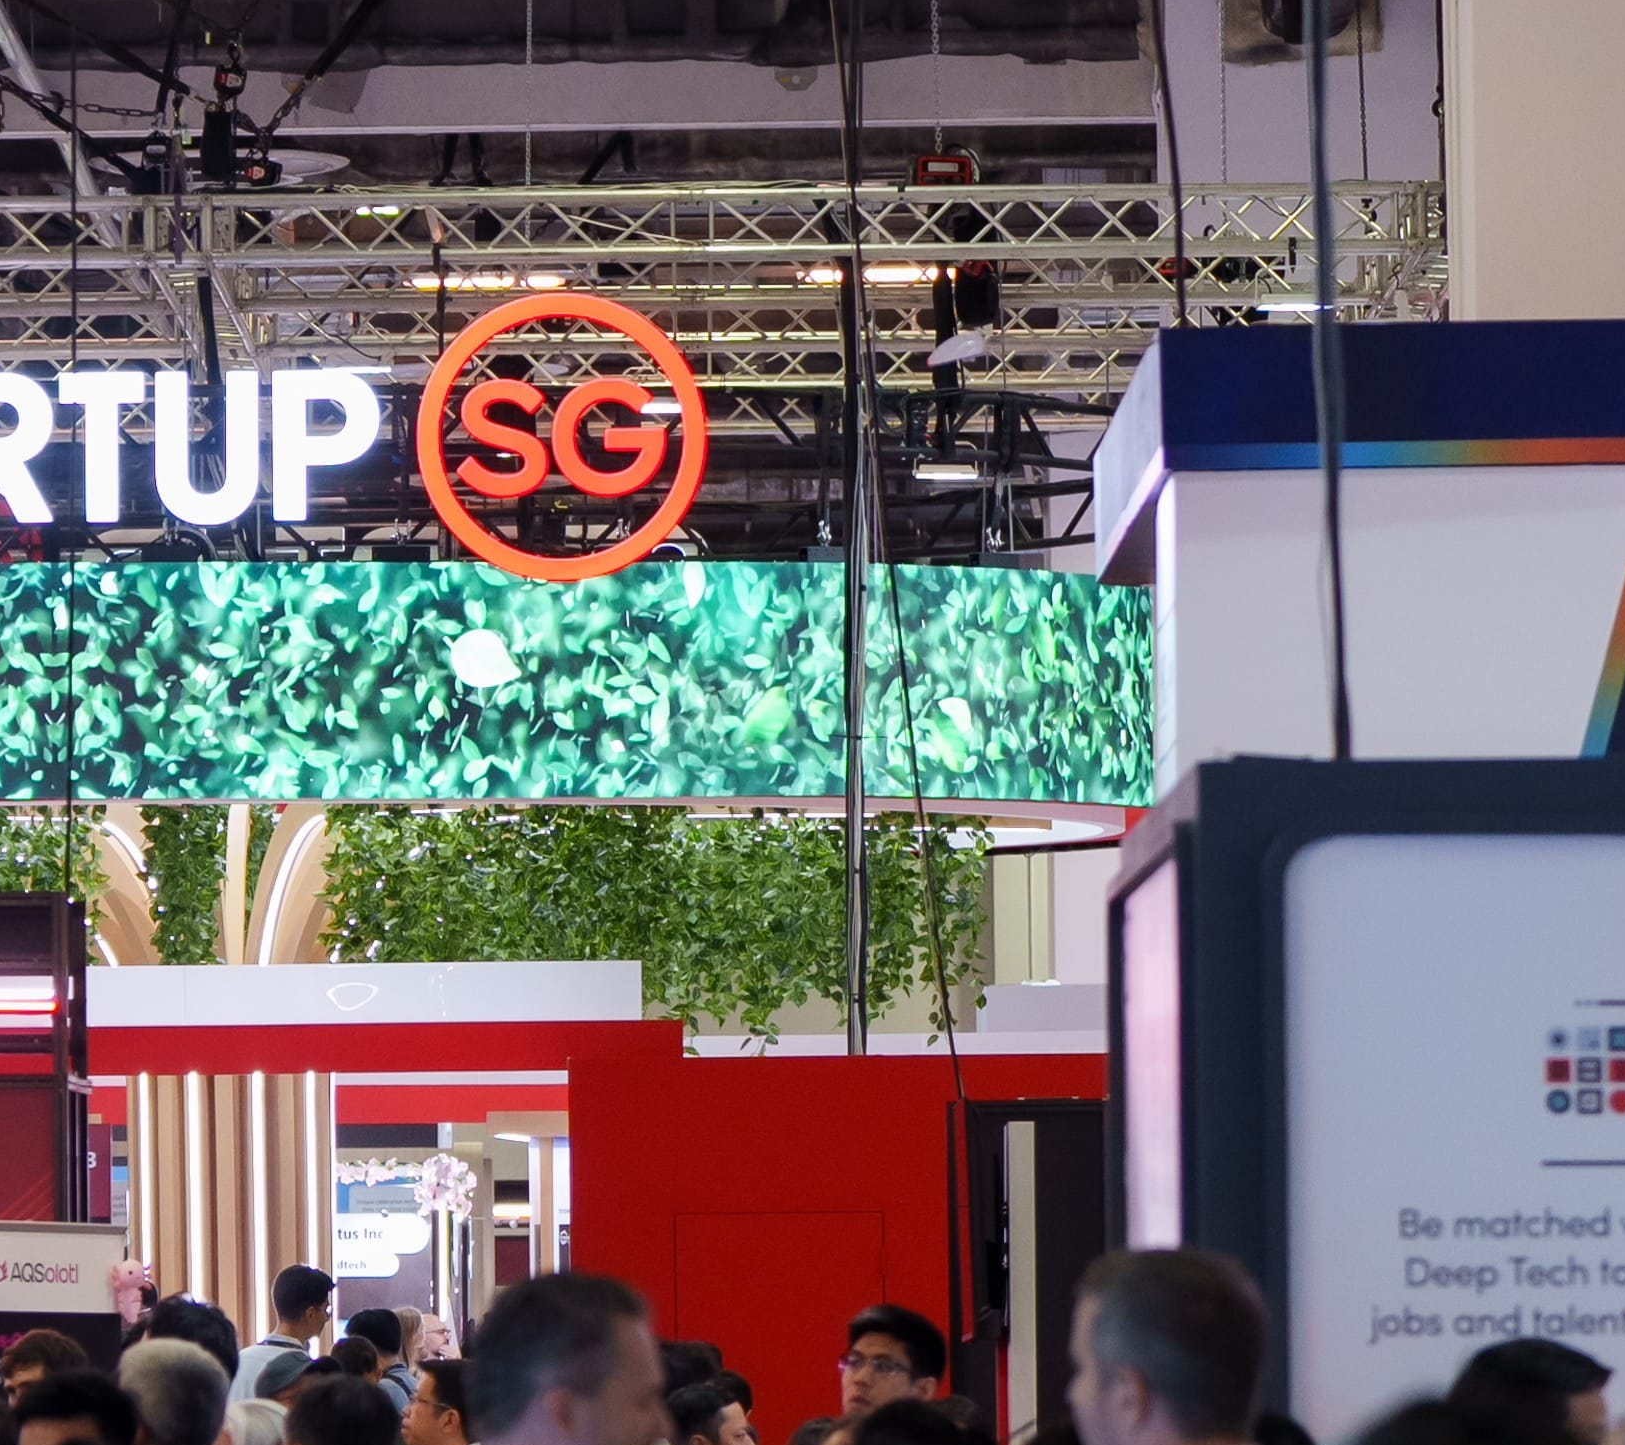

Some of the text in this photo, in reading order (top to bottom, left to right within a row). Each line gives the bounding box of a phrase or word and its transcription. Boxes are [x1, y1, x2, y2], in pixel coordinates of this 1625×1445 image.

[454, 376, 668, 499] SG
[1397, 1208, 1443, 1239] Be
[1453, 1207, 1611, 1240] matched
[10, 1261, 79, 1283] AQSolotl
[1404, 1257, 1499, 1294] Deep
[1510, 1256, 1590, 1288] Tech
[1368, 1305, 1442, 1345] jobs
[1452, 1306, 1521, 1337] and
